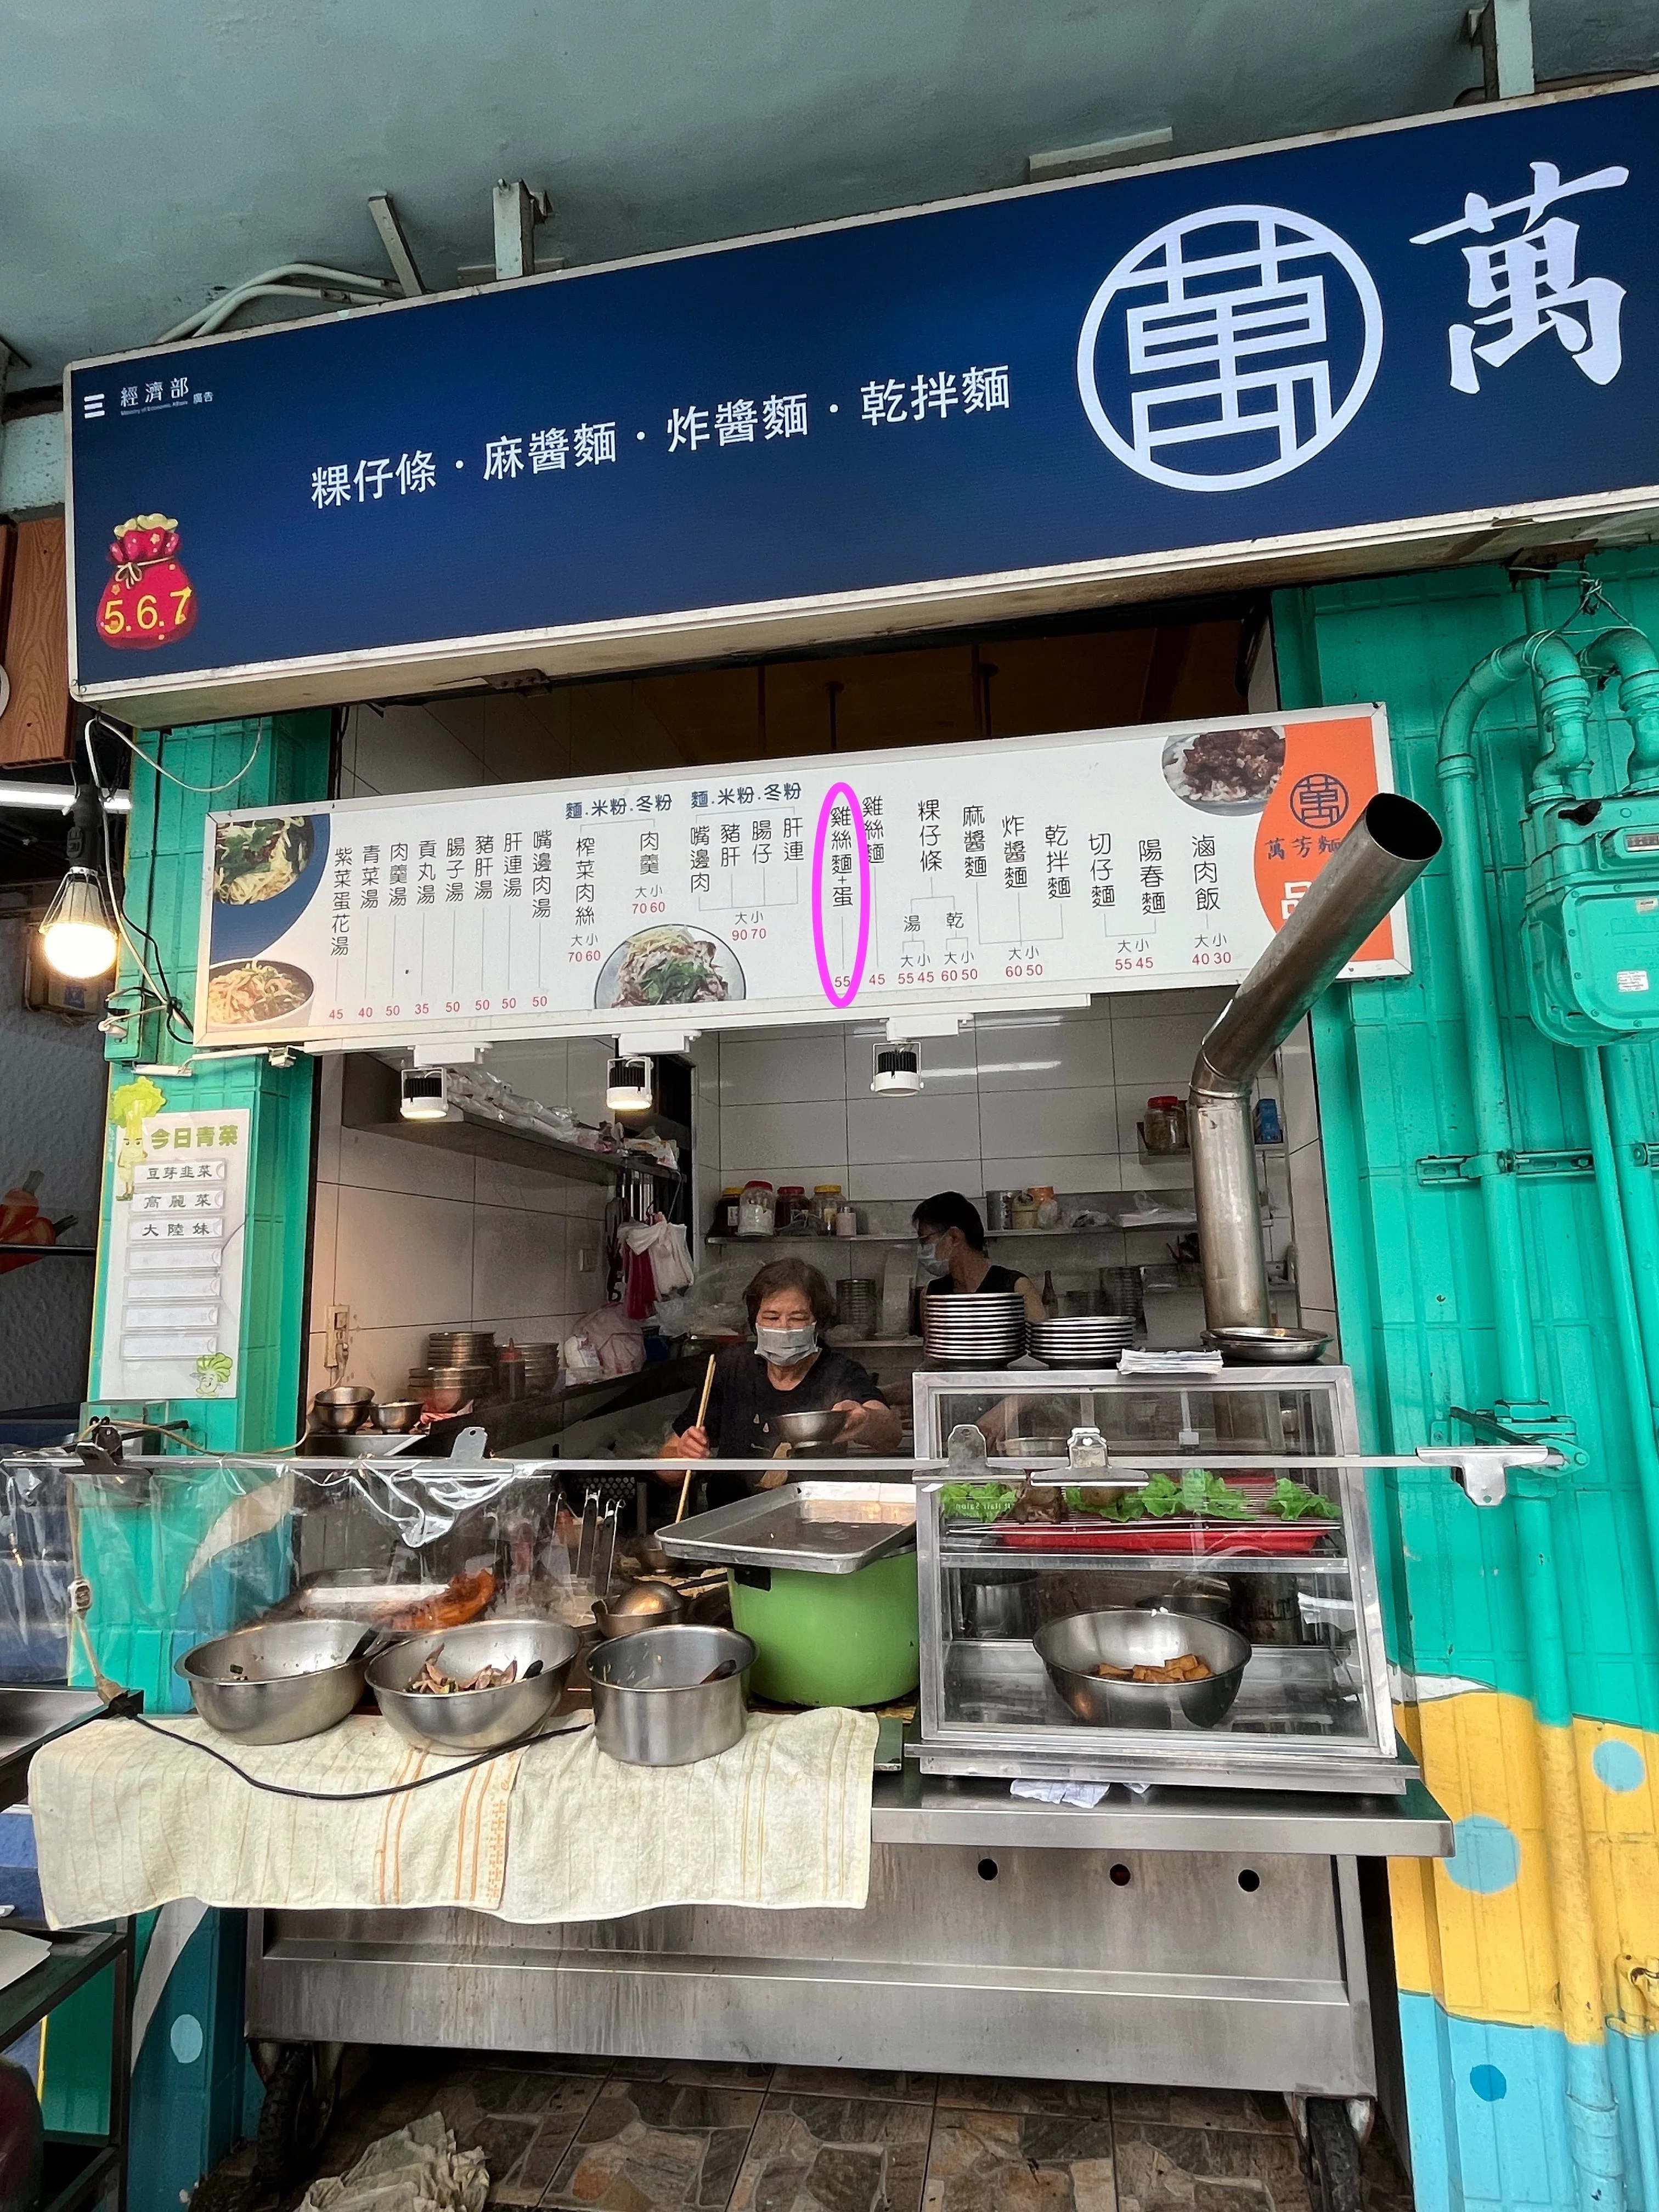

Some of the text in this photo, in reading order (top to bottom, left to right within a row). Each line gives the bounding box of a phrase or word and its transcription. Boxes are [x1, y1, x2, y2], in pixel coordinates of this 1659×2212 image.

[1409, 162, 1629, 394] 萬
[120, 377, 189, 407] 經濟部
[312, 365, 1009, 509] 粿仔條 麻醬麵 炸醬麵 乾拌麵
[105, 586, 191, 634] 5.6.7
[721, 823, 740, 867] 豬肝
[752, 820, 772, 864] 腸仔
[783, 817, 804, 861] 肝連
[862, 795, 884, 863] 雞絲麵
[918, 799, 942, 872] 粿仔條
[963, 805, 987, 878] 麻醬麵
[445, 838, 465, 902] 腸子湯
[474, 834, 494, 900] 豬肝湯
[503, 832, 522, 898] 肝連湯
[640, 831, 659, 875] 肉羹
[690, 826, 710, 893] 嘴邊肉
[1002, 815, 1028, 889] 炸醬麵
[1045, 825, 1071, 899] 乾拌麵
[1088, 833, 1115, 908] 切仔麵
[360, 845, 380, 909] 青菜湯
[388, 842, 408, 907] 肉羹湯
[416, 840, 437, 904] 貢丸湯
[532, 830, 552, 918] 嘴邊肉湯
[575, 838, 595, 926] 榨菜肉絲
[1139, 839, 1166, 915] 陽春麵
[1192, 834, 1221, 910] 滷肉飯
[331, 848, 352, 956] 紫菜蛋花湯
[633, 902, 665, 914] 70 60
[946, 912, 964, 929] 乾
[732, 928, 766, 941] 90 70
[904, 915, 920, 932] 湯
[568, 950, 600, 962] 70 60
[1006, 964, 1042, 977] 60 50
[1115, 957, 1153, 970] 55 45
[1192, 952, 1231, 965] 40 30
[835, 976, 850, 987] 55
[869, 974, 885, 985] 45
[898, 972, 934, 984] 55 45
[941, 969, 977, 981] 60 50
[329, 1009, 343, 1019] 45
[358, 1007, 373, 1017] 40
[386, 1006, 399, 1016] 50
[415, 1003, 428, 1014] 35
[446, 1001, 460, 1012] 50
[476, 1000, 489, 1011] 50
[502, 998, 516, 1009] 50
[533, 996, 547, 1007] 50
[151, 1125, 238, 1149] 今日青菜
[146, 1164, 212, 1180] 豆芽韭菜
[144, 1193, 212, 1209] 高麗菜
[142, 1222, 210, 1237] 大陸妹
